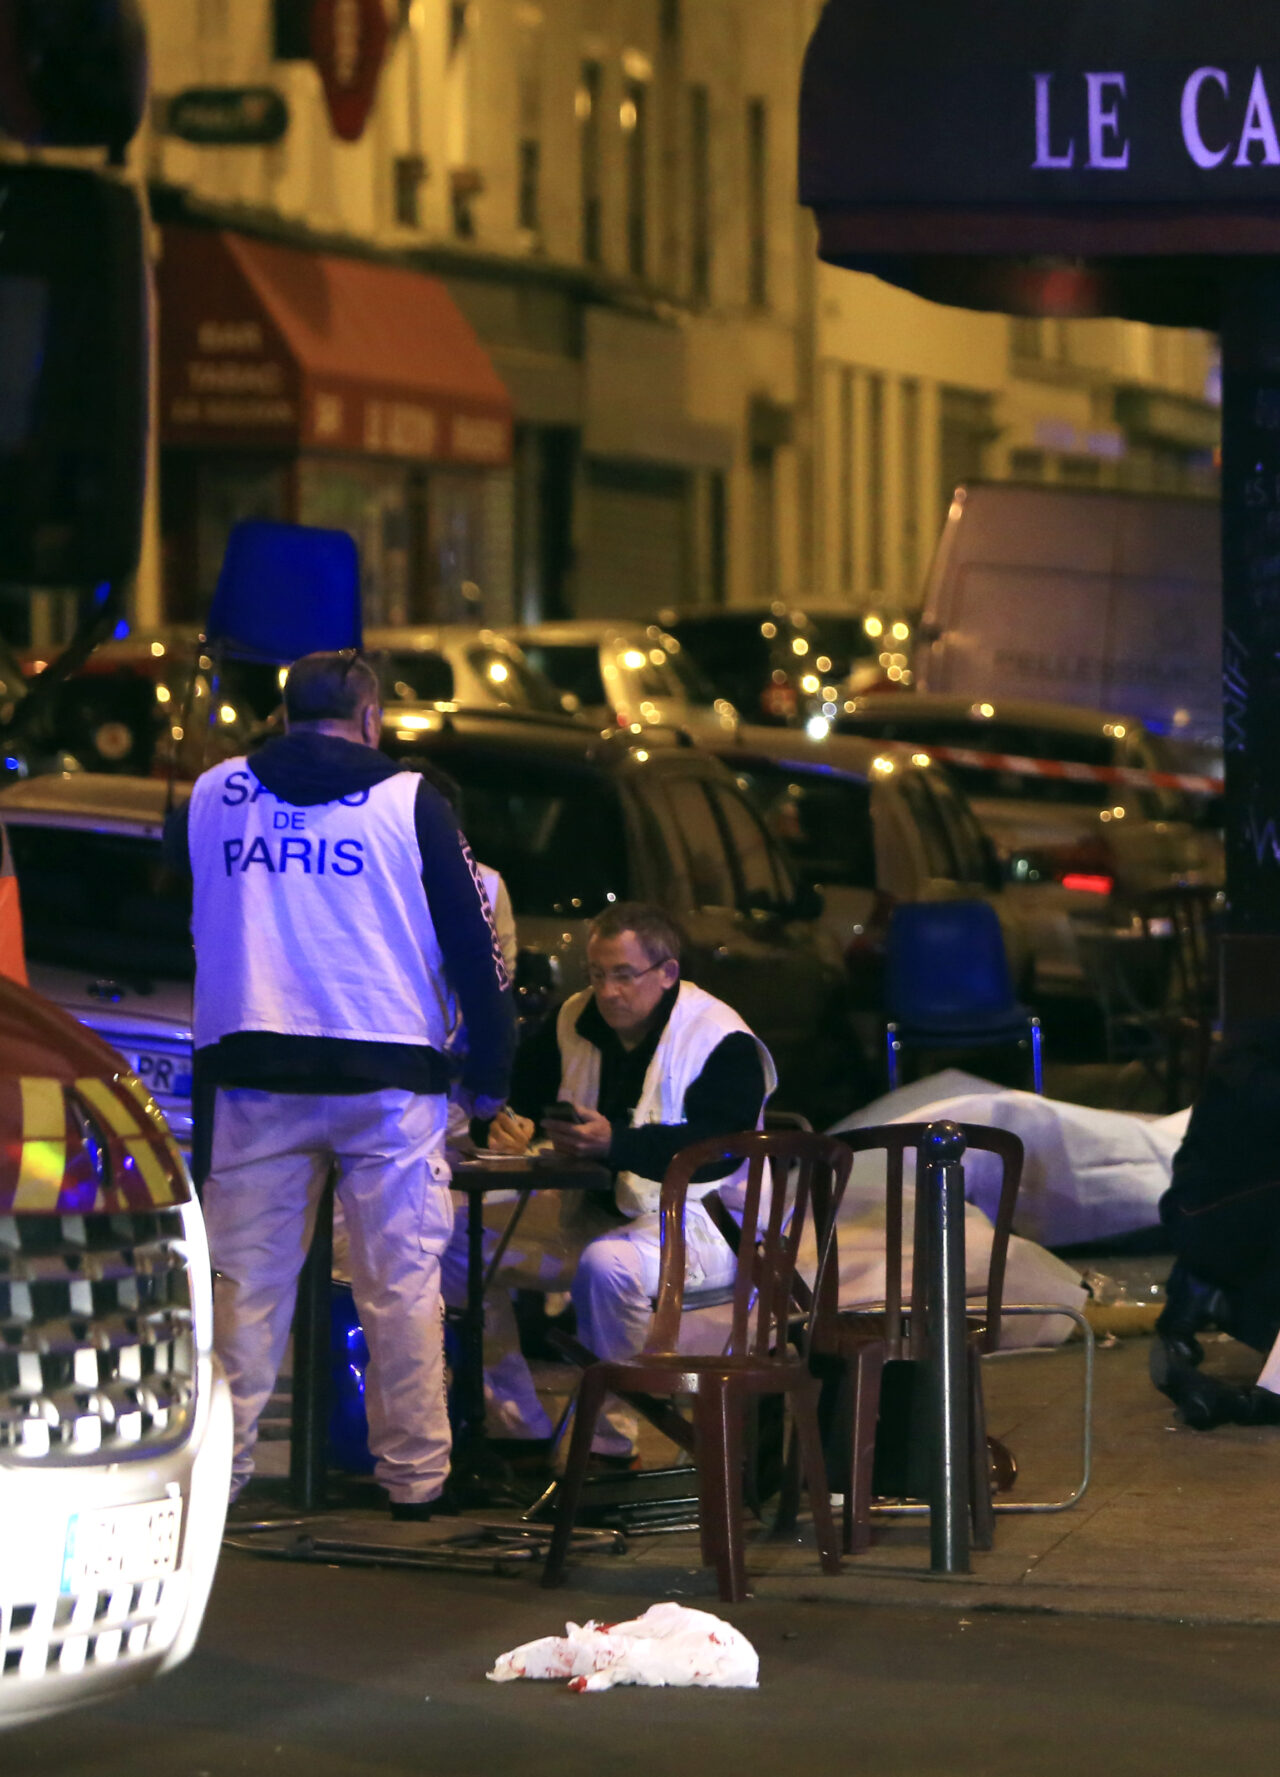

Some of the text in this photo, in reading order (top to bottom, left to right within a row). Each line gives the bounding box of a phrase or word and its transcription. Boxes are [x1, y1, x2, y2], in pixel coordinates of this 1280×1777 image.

[1029, 71, 1131, 170] LE
[273, 811, 306, 830] DE
[223, 836, 364, 877] PARIS
